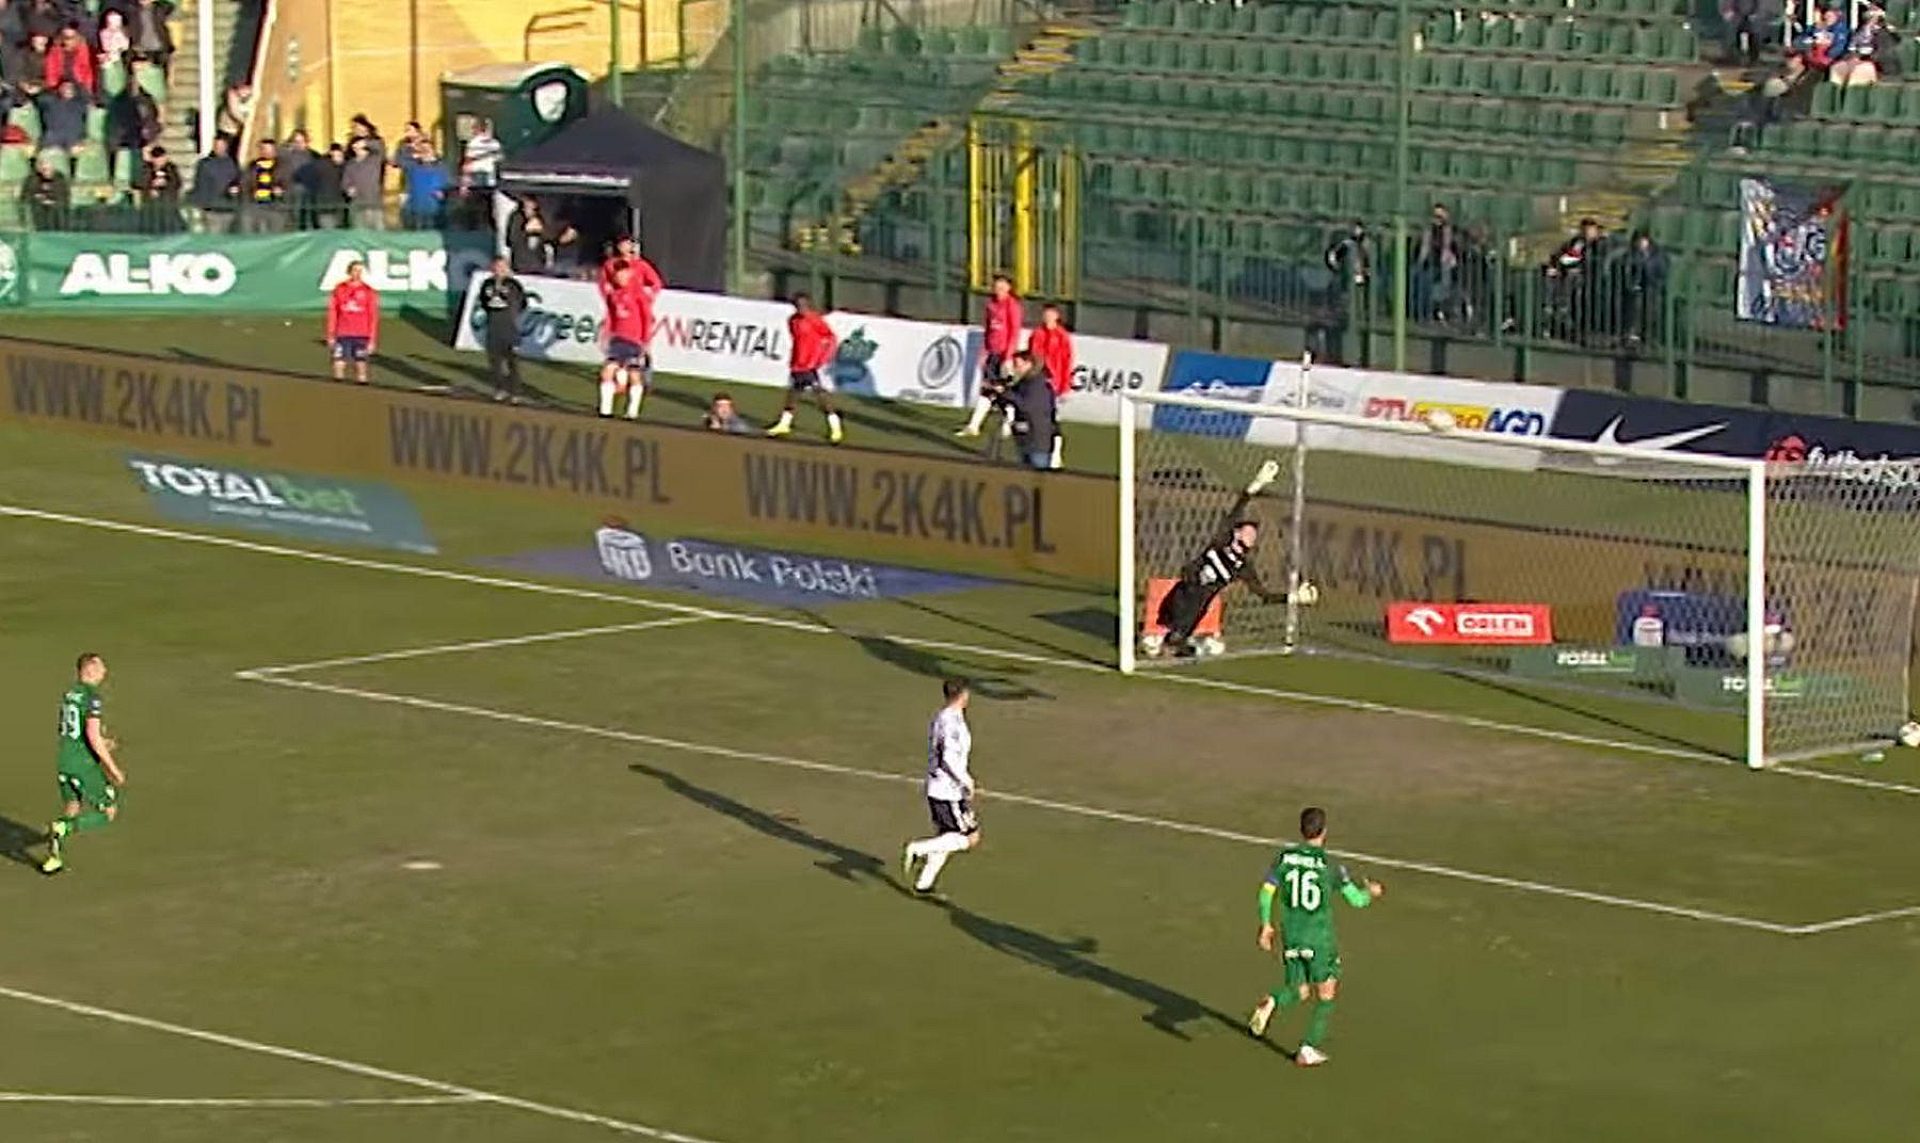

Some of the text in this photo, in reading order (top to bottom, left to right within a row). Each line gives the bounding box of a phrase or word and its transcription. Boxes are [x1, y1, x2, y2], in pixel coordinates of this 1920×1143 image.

[60, 250, 237, 295] AL-KO
[6, 353, 272, 448] WWW.2K4K.PL
[389, 405, 673, 504] WWW.2K4K.PL
[743, 452, 1056, 555] WWW.2K4K.PL
[667, 541, 763, 583] Bank
[769, 556, 878, 598] Polski
[1285, 868, 1321, 911] 16
